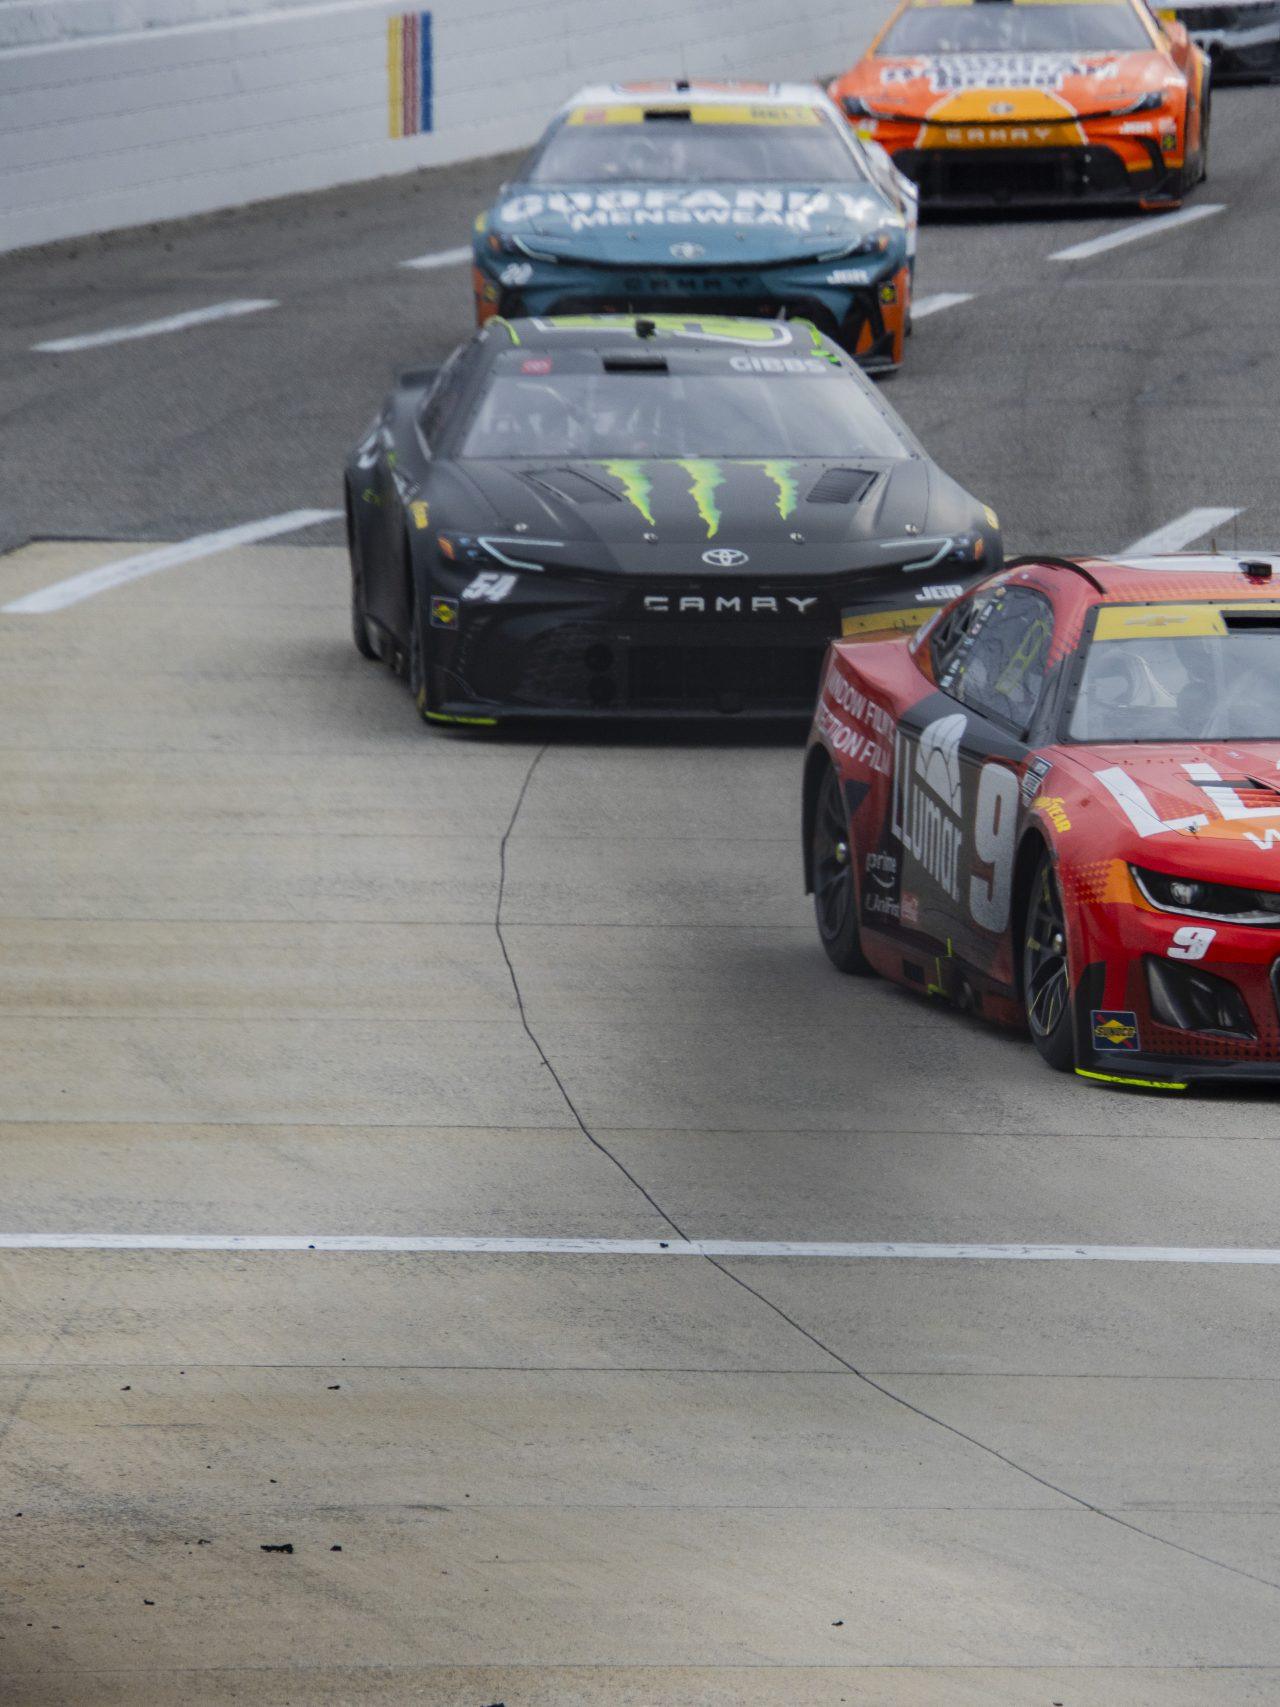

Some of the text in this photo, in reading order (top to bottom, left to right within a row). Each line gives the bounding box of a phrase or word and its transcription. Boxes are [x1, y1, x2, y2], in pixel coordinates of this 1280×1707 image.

[570, 208, 812, 232] MENSWEAR
[729, 356, 827, 373] GIBBS
[461, 571, 519, 602] 54
[914, 584, 965, 601] JGR
[643, 597, 818, 612] CAMRY
[970, 762, 1018, 933] 9
[1166, 926, 1217, 960] 9
